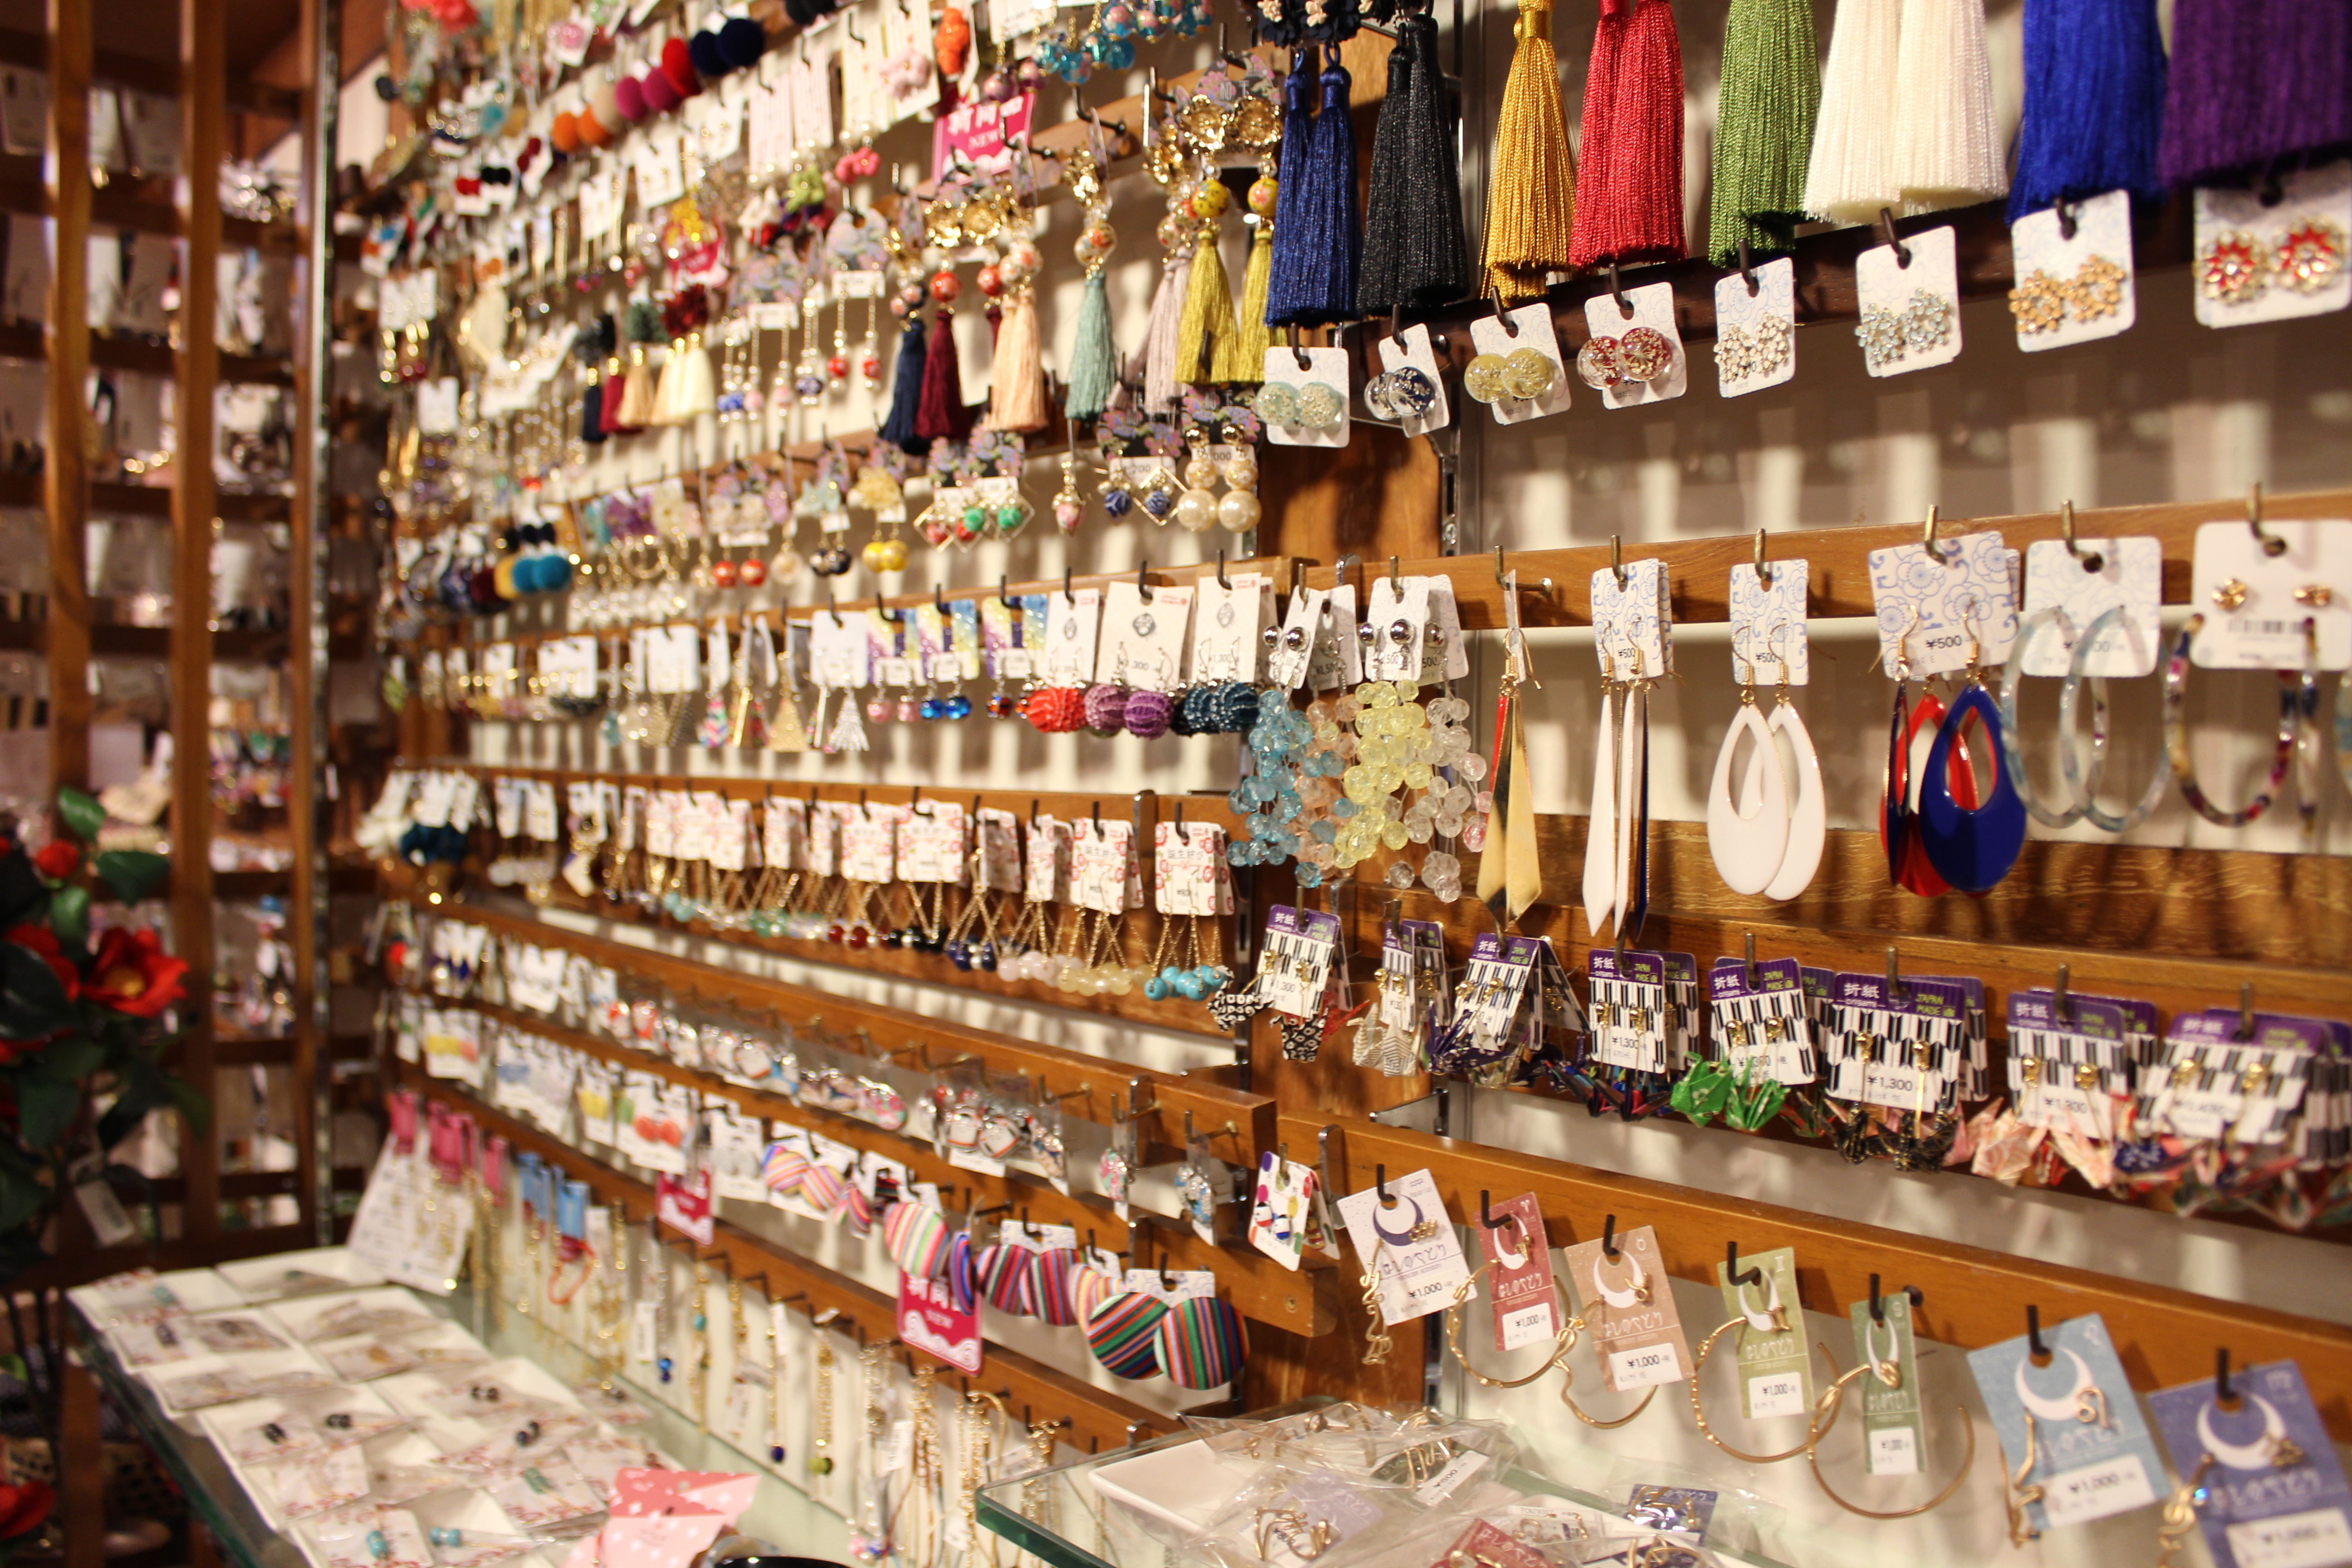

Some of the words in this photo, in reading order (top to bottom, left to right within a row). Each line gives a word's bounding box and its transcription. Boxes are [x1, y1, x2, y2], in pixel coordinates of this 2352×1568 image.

[1926, 635, 1962, 650] ¥500
[1618, 647, 1635, 659] ¥500
[1756, 652, 1776, 662] ¥500
[1274, 912, 1295, 926] 折紙
[1478, 940, 1497, 952] 折紙
[1593, 956, 1615, 970] 折紙
[1714, 975, 1741, 990] 折紙
[1764, 970, 1784, 981] JAPAN
[1766, 981, 1784, 991] MADE
[1844, 982, 1880, 999] 折紙
[1916, 993, 1945, 1005] JAPAN
[1916, 1005, 1941, 1016] MADE
[1867, 1075, 1913, 1092] ¥1,300
[1408, 1282, 1443, 1299] ¥1,000
[1627, 1355, 1660, 1369] ¥1,000
